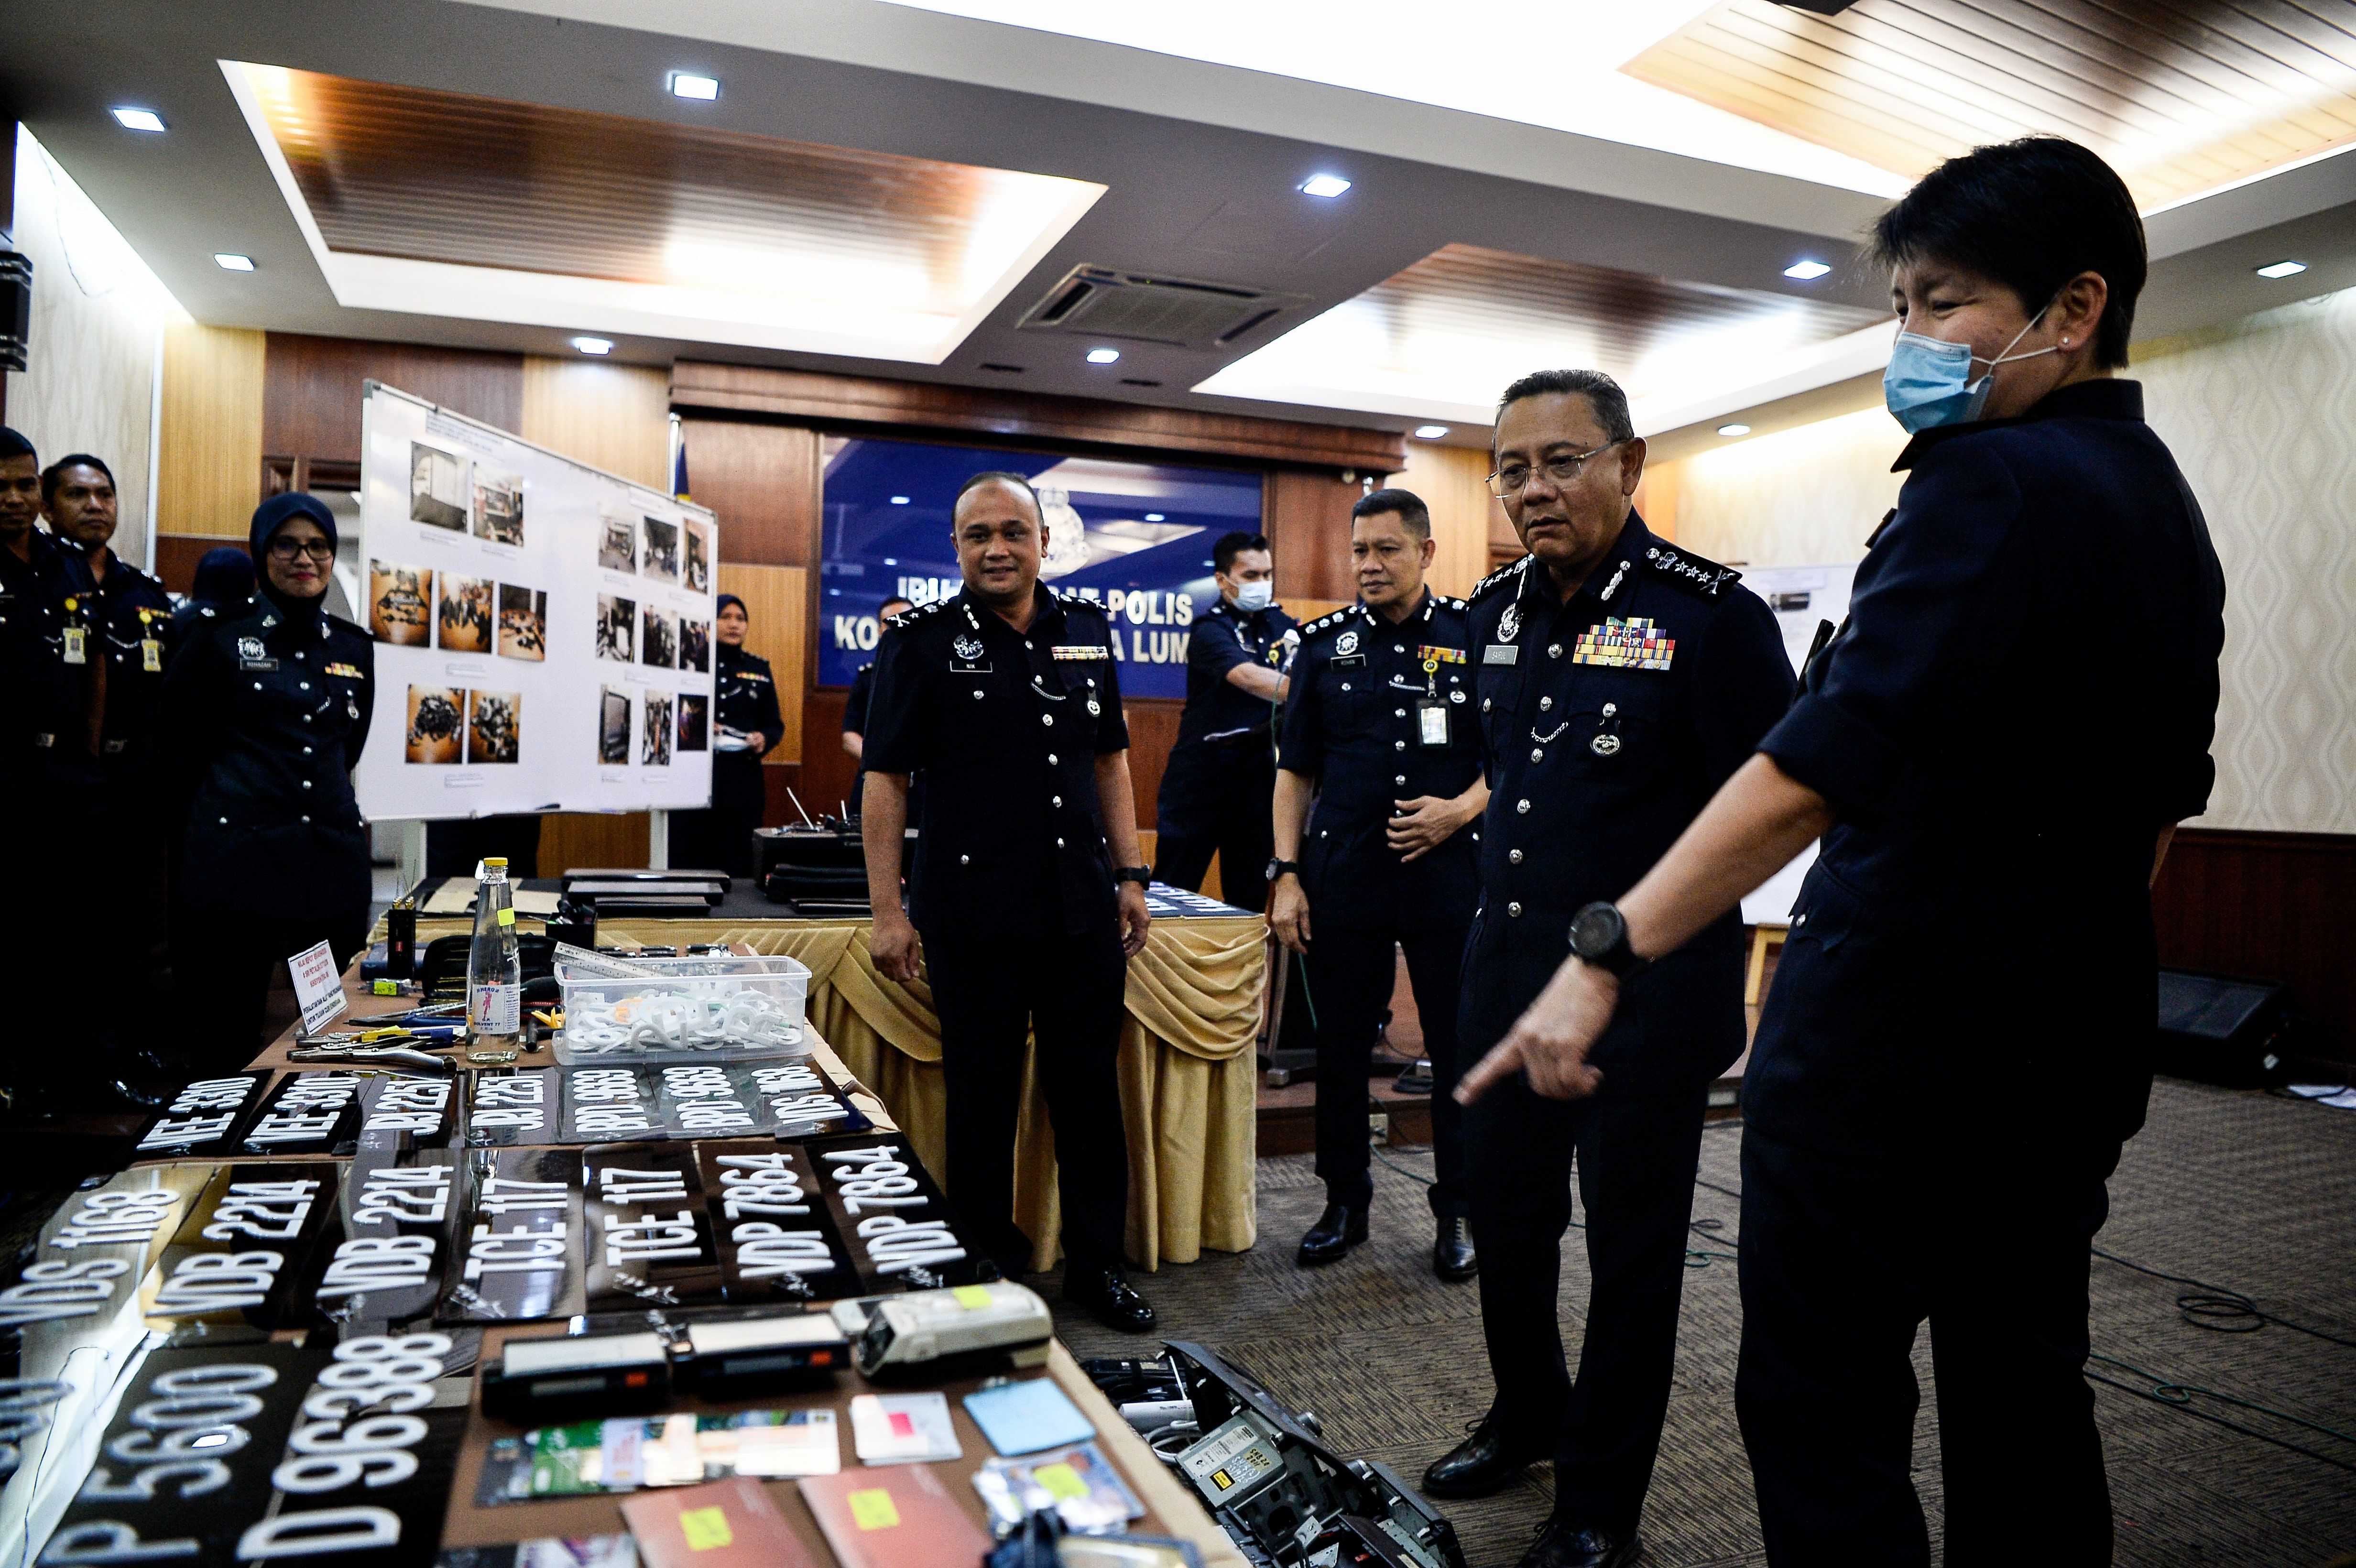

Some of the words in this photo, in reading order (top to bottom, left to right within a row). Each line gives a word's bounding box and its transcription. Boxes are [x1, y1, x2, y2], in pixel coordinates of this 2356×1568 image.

[1107, 589, 1193, 626] POLIS
[1133, 629, 1190, 664] LUM
[168, 1077, 256, 1113] 3310
[274, 1077, 361, 1111] 3310
[374, 1079, 453, 1111] 2251
[474, 1075, 544, 1107] 2251
[572, 1069, 640, 1100] 9669
[662, 1067, 734, 1098] 9669
[751, 1066, 823, 1094] 1168
[243, 1111, 340, 1145] VEE
[575, 1104, 649, 1132] BPD
[676, 1100, 754, 1129] BPD
[770, 1094, 849, 1124] VDS
[136, 1112, 236, 1150] VEE
[353, 1165, 454, 1224] 2214
[479, 1178, 568, 1214] 117
[600, 1168, 687, 1204] 117
[716, 1153, 810, 1220] 7864
[821, 1145, 928, 1215] 7864
[50, 1190, 180, 1249] 1168
[202, 1179, 320, 1241] 2214
[464, 1222, 566, 1280] TCE
[604, 1210, 702, 1266] TCE
[732, 1222, 836, 1278] VDP
[857, 1215, 967, 1274] VDP
[146, 1250, 284, 1318] VDB
[315, 1235, 436, 1299] VDB
[0, 1259, 130, 1326] VDS
[79, 1363, 279, 1502] 5600
[271, 1332, 453, 1494] 96388
[33, 1518, 201, 1565] P
[236, 1505, 402, 1562] D
